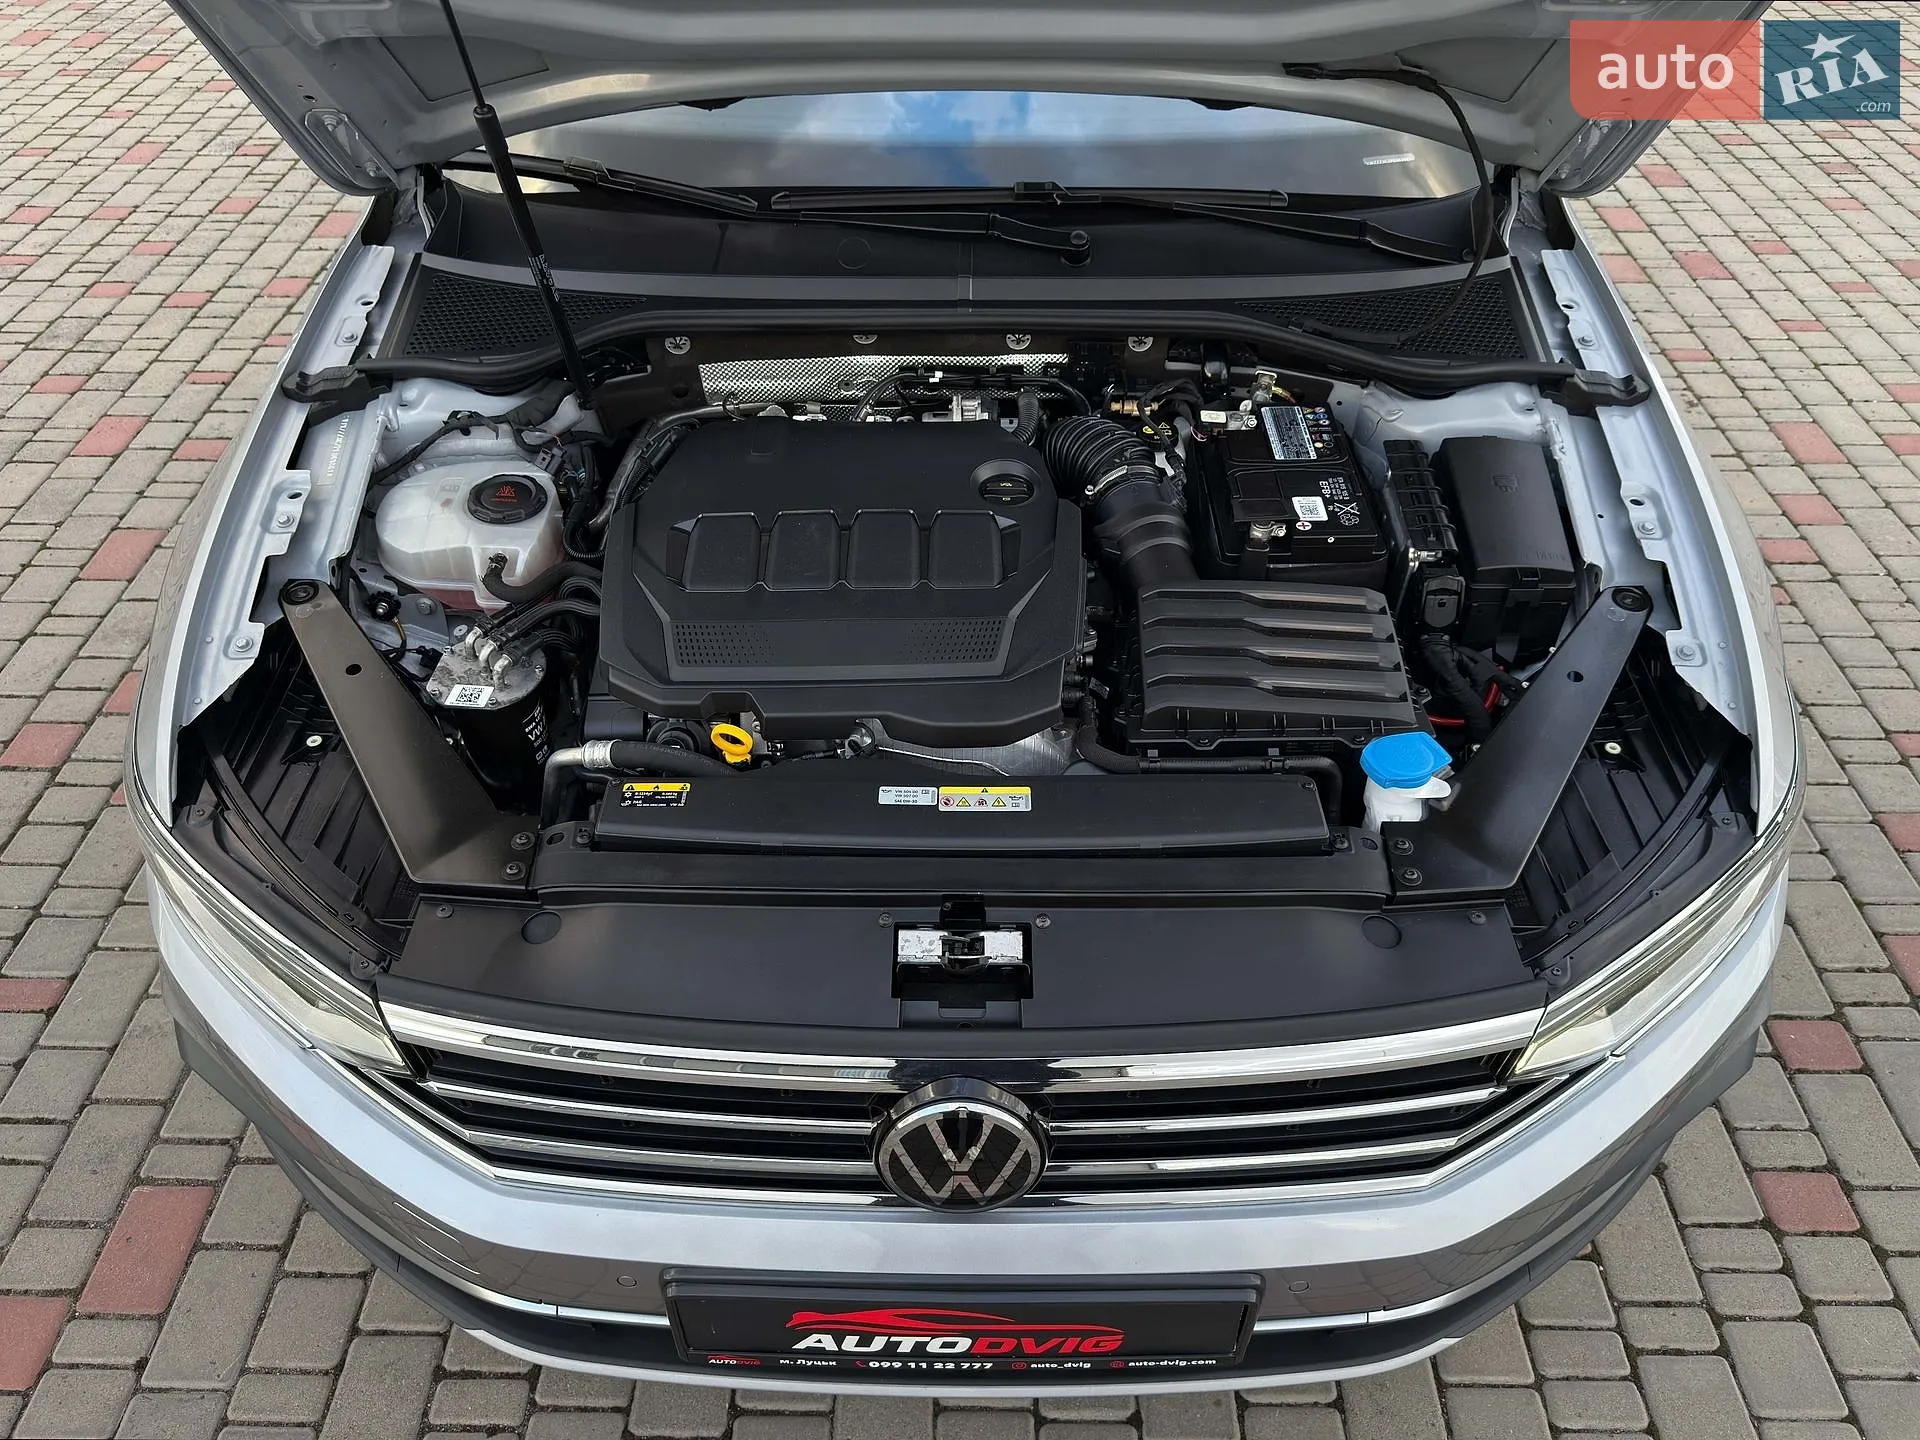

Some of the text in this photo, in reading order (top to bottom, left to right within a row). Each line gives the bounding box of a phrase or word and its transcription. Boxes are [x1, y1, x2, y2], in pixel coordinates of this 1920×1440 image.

[792, 1334, 1126, 1354] AUTODVIG
[868, 1361, 903, 1369] 099
[1030, 1361, 1092, 1369] auto_dvig
[1128, 1359, 1217, 1367] auto-dvig.com
